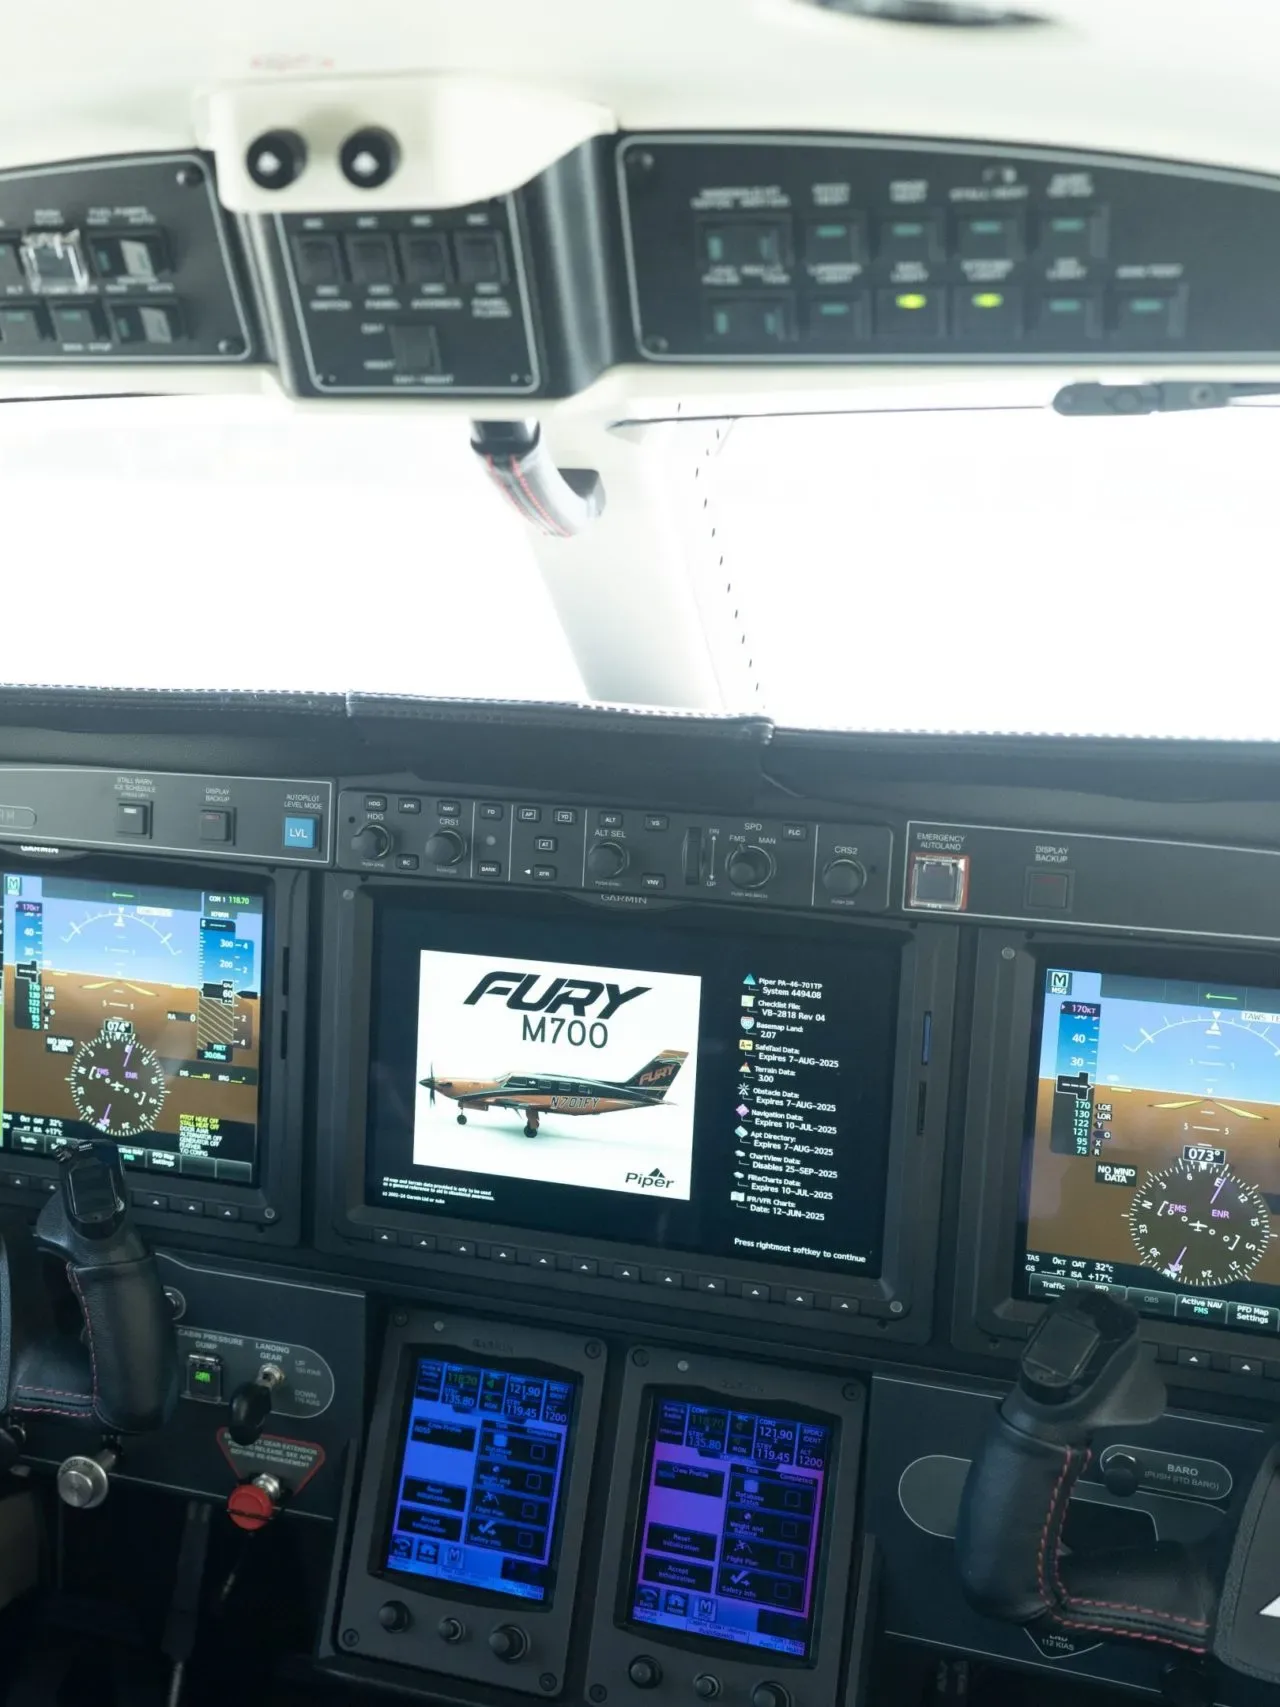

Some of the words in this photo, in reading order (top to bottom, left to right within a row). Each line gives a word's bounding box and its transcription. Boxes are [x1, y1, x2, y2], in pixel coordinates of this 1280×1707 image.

[206, 787, 229, 795] DISPLAY
[304, 802, 323, 810] MODE
[367, 813, 384, 822] HDG
[439, 818, 460, 826] CRS1
[744, 822, 762, 832] SPD
[289, 828, 307, 838] LVL
[594, 829, 609, 837] ALT
[611, 831, 626, 839] SEL
[916, 832, 965, 843] EMERGENCY
[758, 837, 776, 845] MAN
[920, 841, 962, 850] AUTOLAND
[834, 846, 858, 855] CRS2
[1035, 845, 1068, 855] DISPLAY
[1035, 854, 1068, 864] BACKUP
[229, 897, 249, 905] 118.70
[601, 894, 647, 905] GARMIN
[220, 939, 233, 948] 300
[220, 960, 233, 968] 200
[759, 978, 776, 986] Piper
[778, 980, 822, 990] PA-46-701TP
[463, 971, 652, 1019] FURY
[763, 987, 789, 996] System
[791, 990, 822, 999] 4494.08
[758, 1000, 786, 1008] Checklist
[1072, 1004, 1096, 1014] 170KT
[762, 1009, 796, 1019] VB-2818
[798, 1013, 812, 1021] Rev
[522, 1014, 608, 1048] M700
[756, 1022, 785, 1032] Basemap
[760, 1031, 776, 1039] 2.07
[1072, 1034, 1085, 1043] 40
[755, 1044, 781, 1052] SafeTaxi
[783, 1046, 800, 1054] Data:
[759, 1053, 786, 1062] Expires
[789, 1056, 839, 1068] 7-AUG-2025
[1070, 1057, 1084, 1066] 30
[640, 1065, 675, 1084] FURY
[754, 1066, 777, 1074] Terrain
[758, 1075, 774, 1083] 3.00
[753, 1088, 781, 1097] Obstacle
[782, 1091, 800, 1099] Data:
[550, 1096, 600, 1109] N701FY
[756, 1096, 783, 1106] Expires
[786, 1100, 836, 1112] 7-AUG-2025
[1075, 1101, 1091, 1110] 170
[1098, 1103, 1112, 1112] LOE
[751, 1110, 785, 1120] Navigation
[786, 1113, 803, 1121] Data:
[1075, 1110, 1090, 1119] 130
[1097, 1112, 1111, 1120] LOR
[755, 1118, 782, 1128] Expires
[785, 1122, 837, 1134] 10-JUL-2025
[1074, 1119, 1089, 1128] 122
[764, 1133, 796, 1143] Directory:
[1073, 1128, 1088, 1137] 121
[1077, 1137, 1088, 1146] 95
[754, 1140, 781, 1150] Expires
[784, 1143, 833, 1156] 7-AUG-2025
[1076, 1147, 1087, 1155] 75
[749, 1153, 782, 1162] ChartView
[783, 1157, 801, 1165] Data:
[1188, 1148, 1221, 1162] 073°
[752, 1161, 783, 1172] Disables
[785, 1166, 838, 1178] 25-SEP-2025
[1097, 1165, 1112, 1176] NO
[1113, 1167, 1136, 1177] WIND
[625, 1172, 674, 1188] Piper
[748, 1174, 782, 1185] FliteCharts
[783, 1179, 801, 1187] Data:
[1104, 1173, 1127, 1184] DATA
[751, 1183, 779, 1193] Expires
[781, 1187, 833, 1200] 10-JUL-2025
[747, 1196, 771, 1205] IFR/VFR
[773, 1199, 796, 1208] Charts:
[750, 1204, 770, 1213] Date:
[773, 1208, 824, 1221] 12-JUN-2025
[1169, 1204, 1187, 1213] FMS
[1212, 1209, 1230, 1219] ENR
[734, 1237, 754, 1247] Press
[756, 1241, 790, 1252] rightmost
[793, 1247, 821, 1257] softkey
[833, 1253, 866, 1263] continue
[1052, 1257, 1067, 1265] 0KT
[1042, 1281, 1066, 1290] Traffic
[1181, 1297, 1205, 1307] Active
[1207, 1301, 1223, 1309] NAV
[1193, 1306, 1209, 1315] FMS
[1237, 1305, 1252, 1313] PFD
[1253, 1308, 1269, 1316] Map
[1236, 1313, 1269, 1324] Settings
[255, 1342, 290, 1354] LANDING
[260, 1352, 282, 1361] GEAR
[509, 1383, 541, 1397] 121.90
[507, 1403, 537, 1419] 119.45
[545, 1410, 567, 1423] 1200
[760, 1426, 793, 1440] 121.90
[758, 1449, 790, 1463] 119.45
[800, 1455, 823, 1467] 1200
[1167, 1463, 1199, 1477] BARO
[1041, 1638, 1054, 1649] 112
[1055, 1640, 1074, 1651] KIAS
